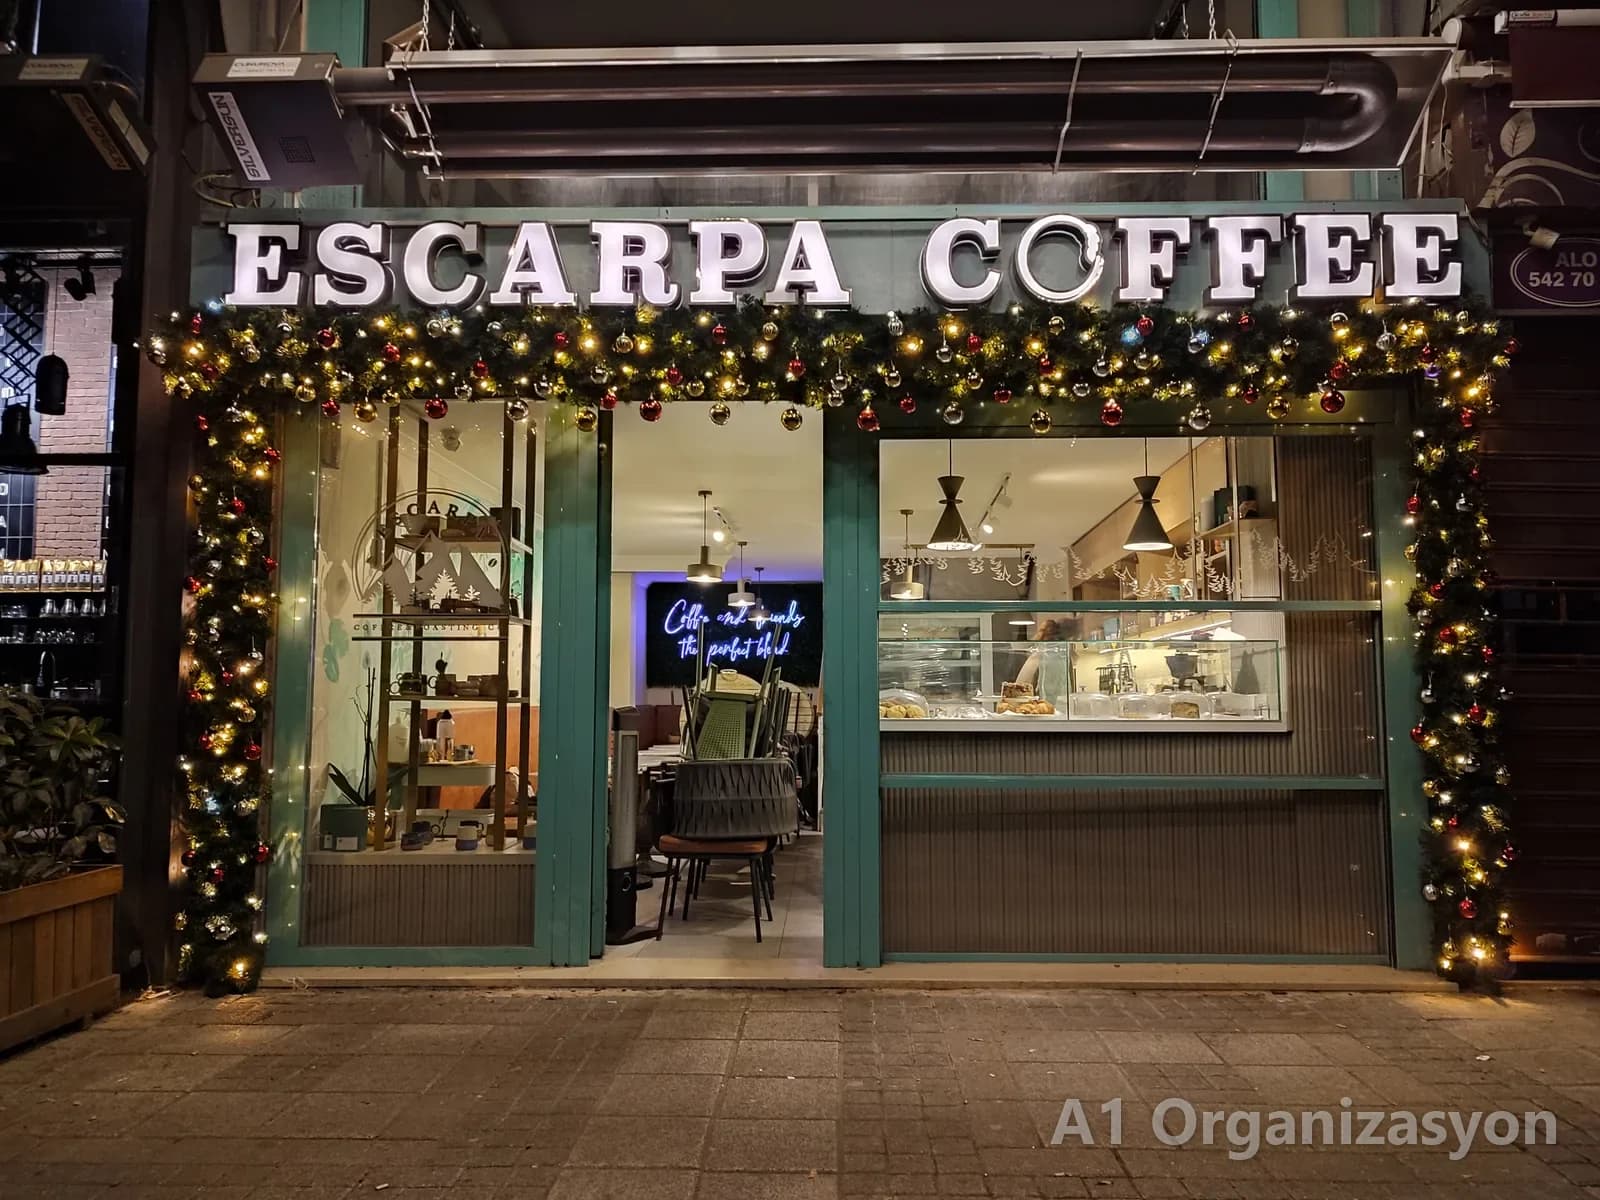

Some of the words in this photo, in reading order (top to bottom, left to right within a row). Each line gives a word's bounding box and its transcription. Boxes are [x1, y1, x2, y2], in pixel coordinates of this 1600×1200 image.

[212, 94, 261, 178] SILVERSUN
[225, 220, 853, 306] ESCARPA
[922, 213, 1462, 303] COFFEE
[1555, 251, 1598, 267] ALO
[1528, 271, 1565, 287] 542
[1570, 271, 1595, 287] 70
[716, 605, 747, 626] and
[678, 635, 699, 660] the
[705, 636, 757, 668] perfect
